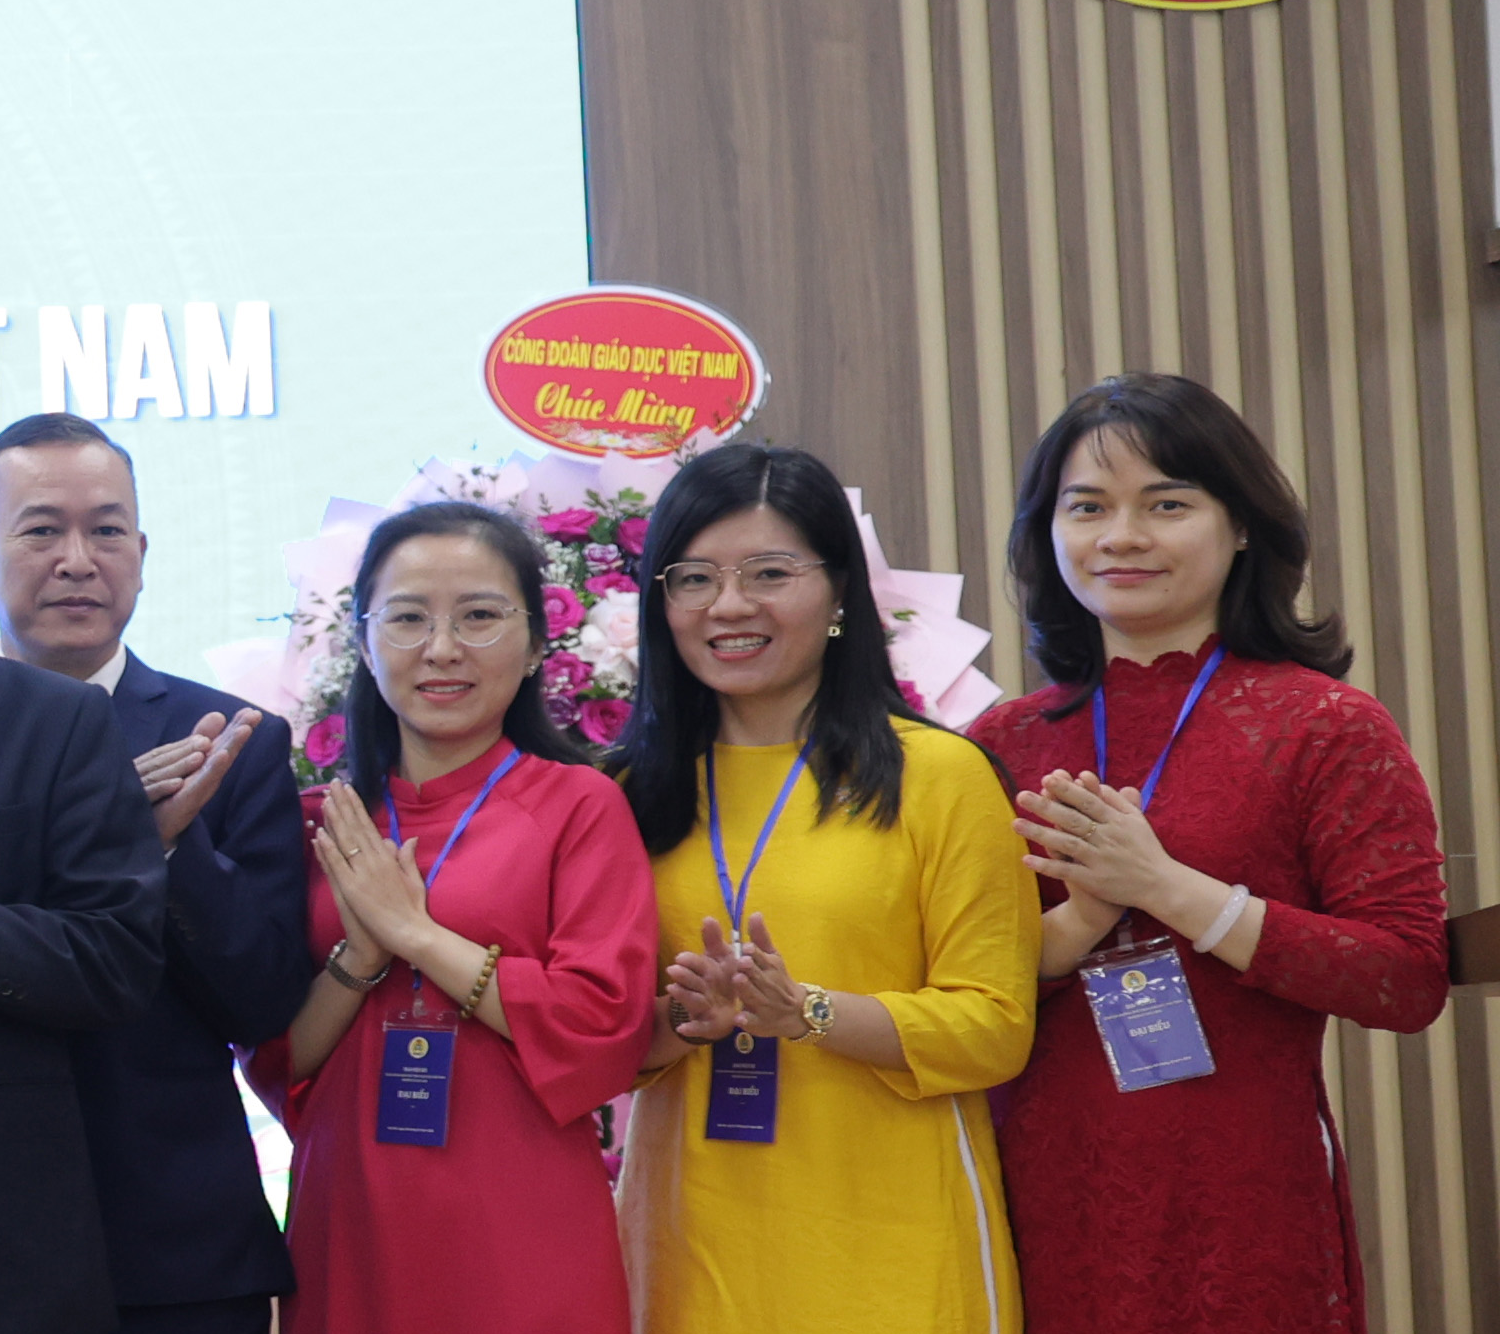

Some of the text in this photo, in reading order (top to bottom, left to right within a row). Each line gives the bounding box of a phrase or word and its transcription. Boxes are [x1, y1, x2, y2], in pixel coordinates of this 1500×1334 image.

[37, 299, 275, 420] NAM
[502, 330, 739, 383] CÔNG ĐOÀN GIÁO DỤC VIỆT NAM
[535, 381, 696, 434] Chúc Mừng
